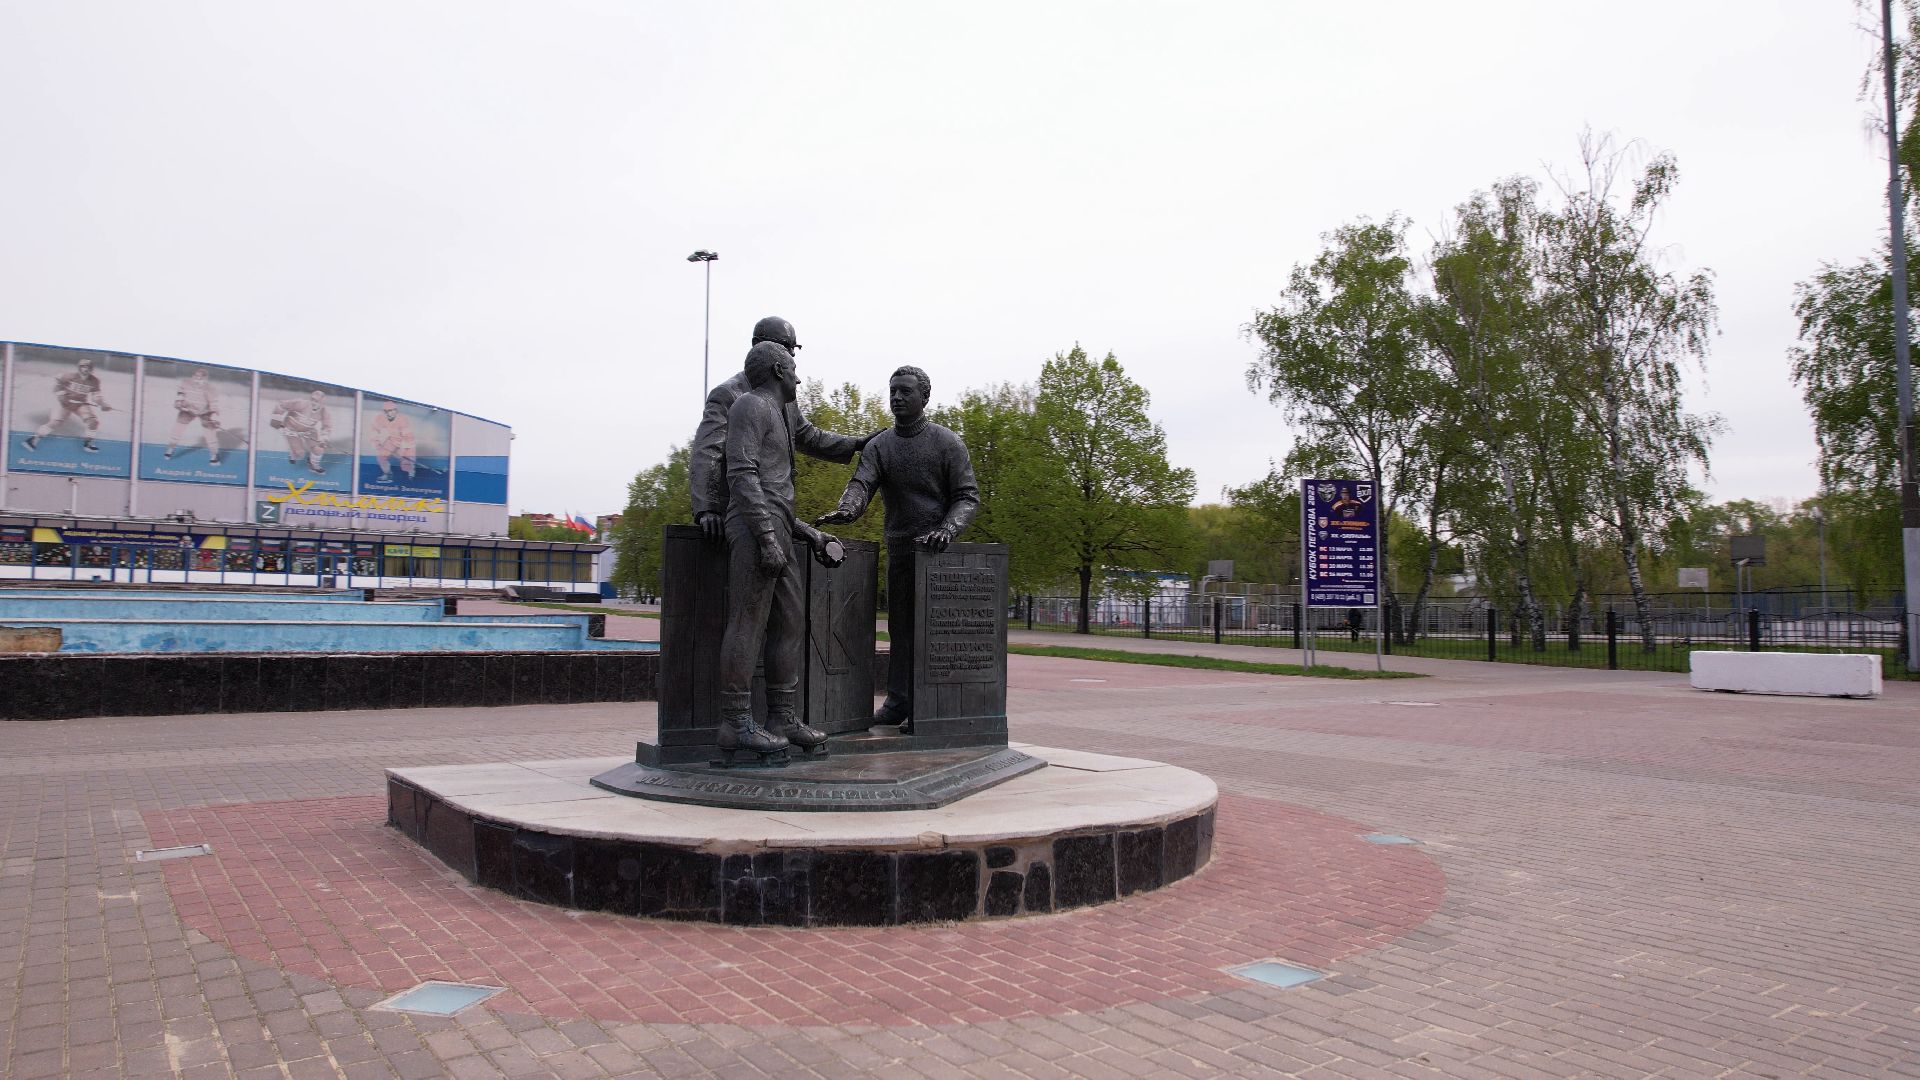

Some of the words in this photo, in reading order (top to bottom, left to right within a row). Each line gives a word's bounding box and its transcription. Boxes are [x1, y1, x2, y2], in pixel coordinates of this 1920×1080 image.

[266, 479, 446, 514] Химик
[1307, 484, 1316, 506] 2023
[261, 504, 275, 520] Z
[284, 505, 361, 519] ледовый
[367, 510, 427, 525] дворец
[1308, 508, 1316, 548] ПЕТРОВА
[1309, 550, 1317, 580] КУБОК
[930, 572, 995, 584] ЭПШТЕЙН
[930, 607, 995, 618] ДОКТОРОВ
